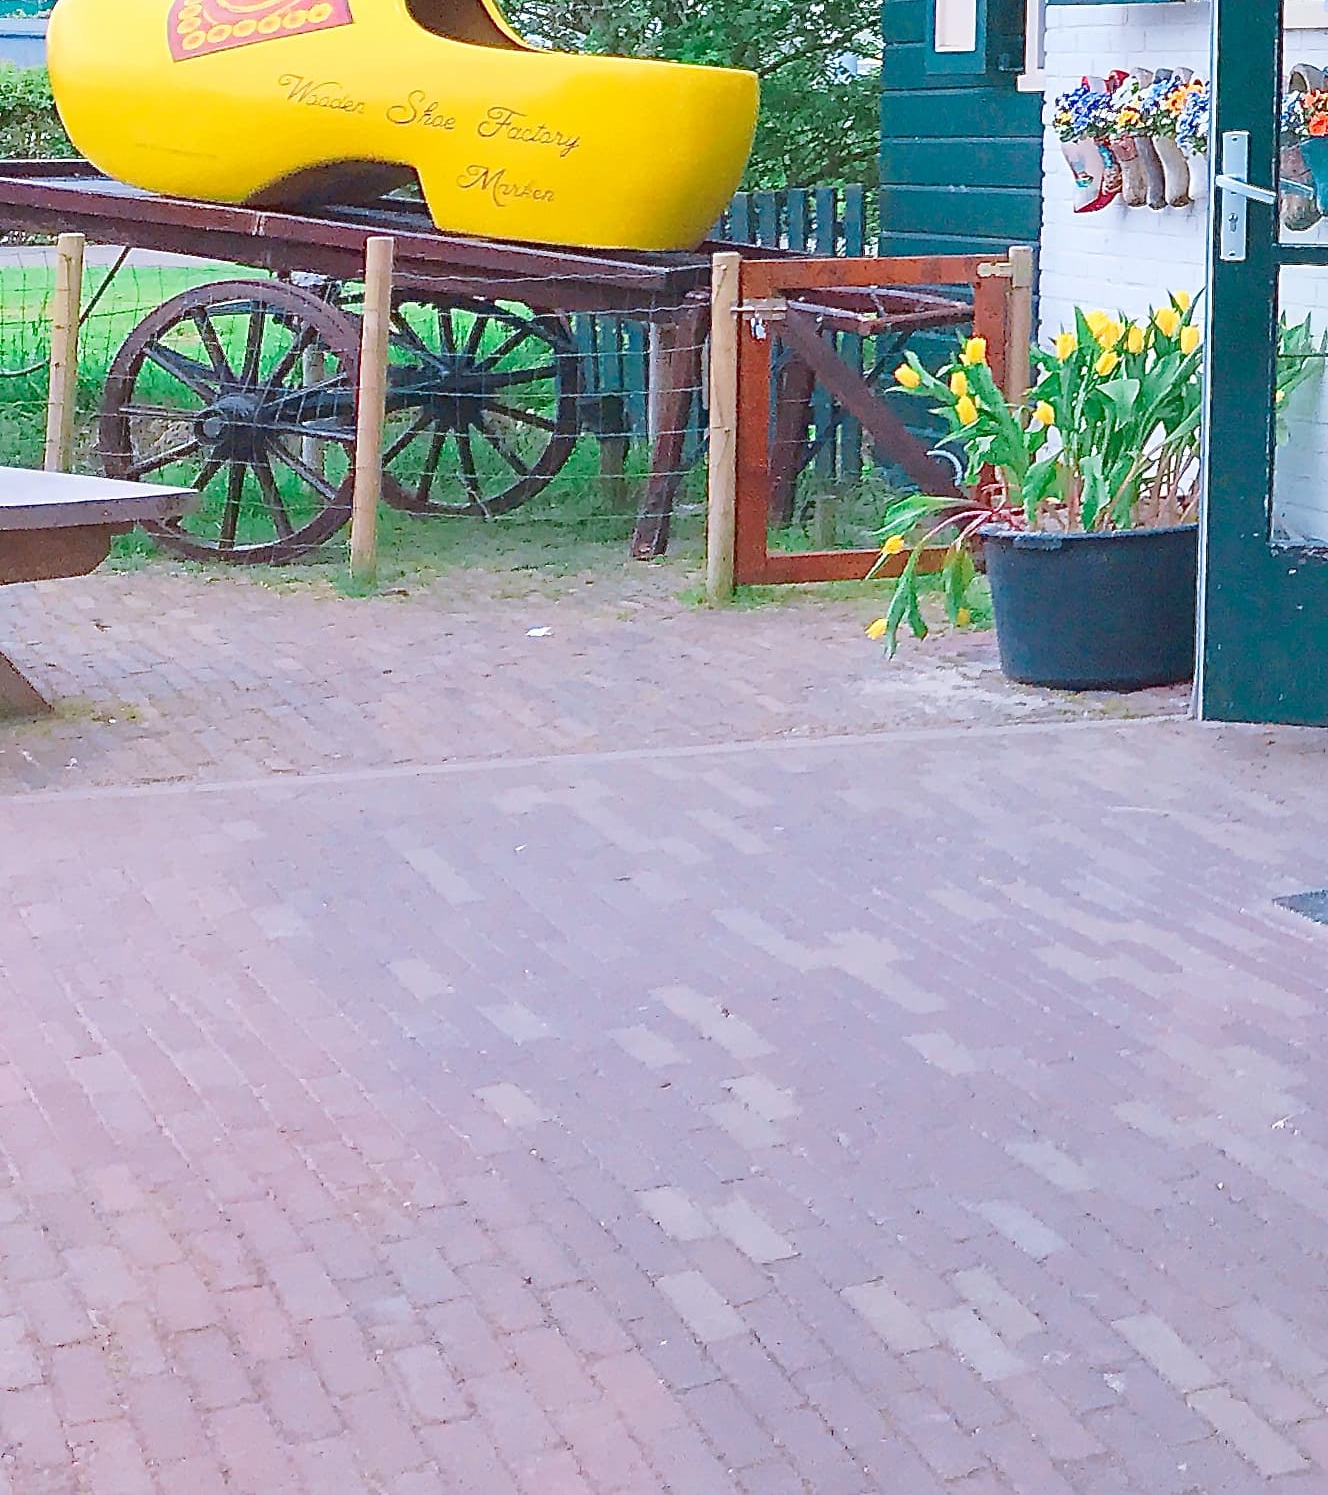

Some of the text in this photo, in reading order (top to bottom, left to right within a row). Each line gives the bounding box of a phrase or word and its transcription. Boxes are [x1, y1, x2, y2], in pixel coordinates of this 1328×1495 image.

[278, 73, 579, 158] Wooden Shoe Factory
[456, 164, 556, 208] Marken
